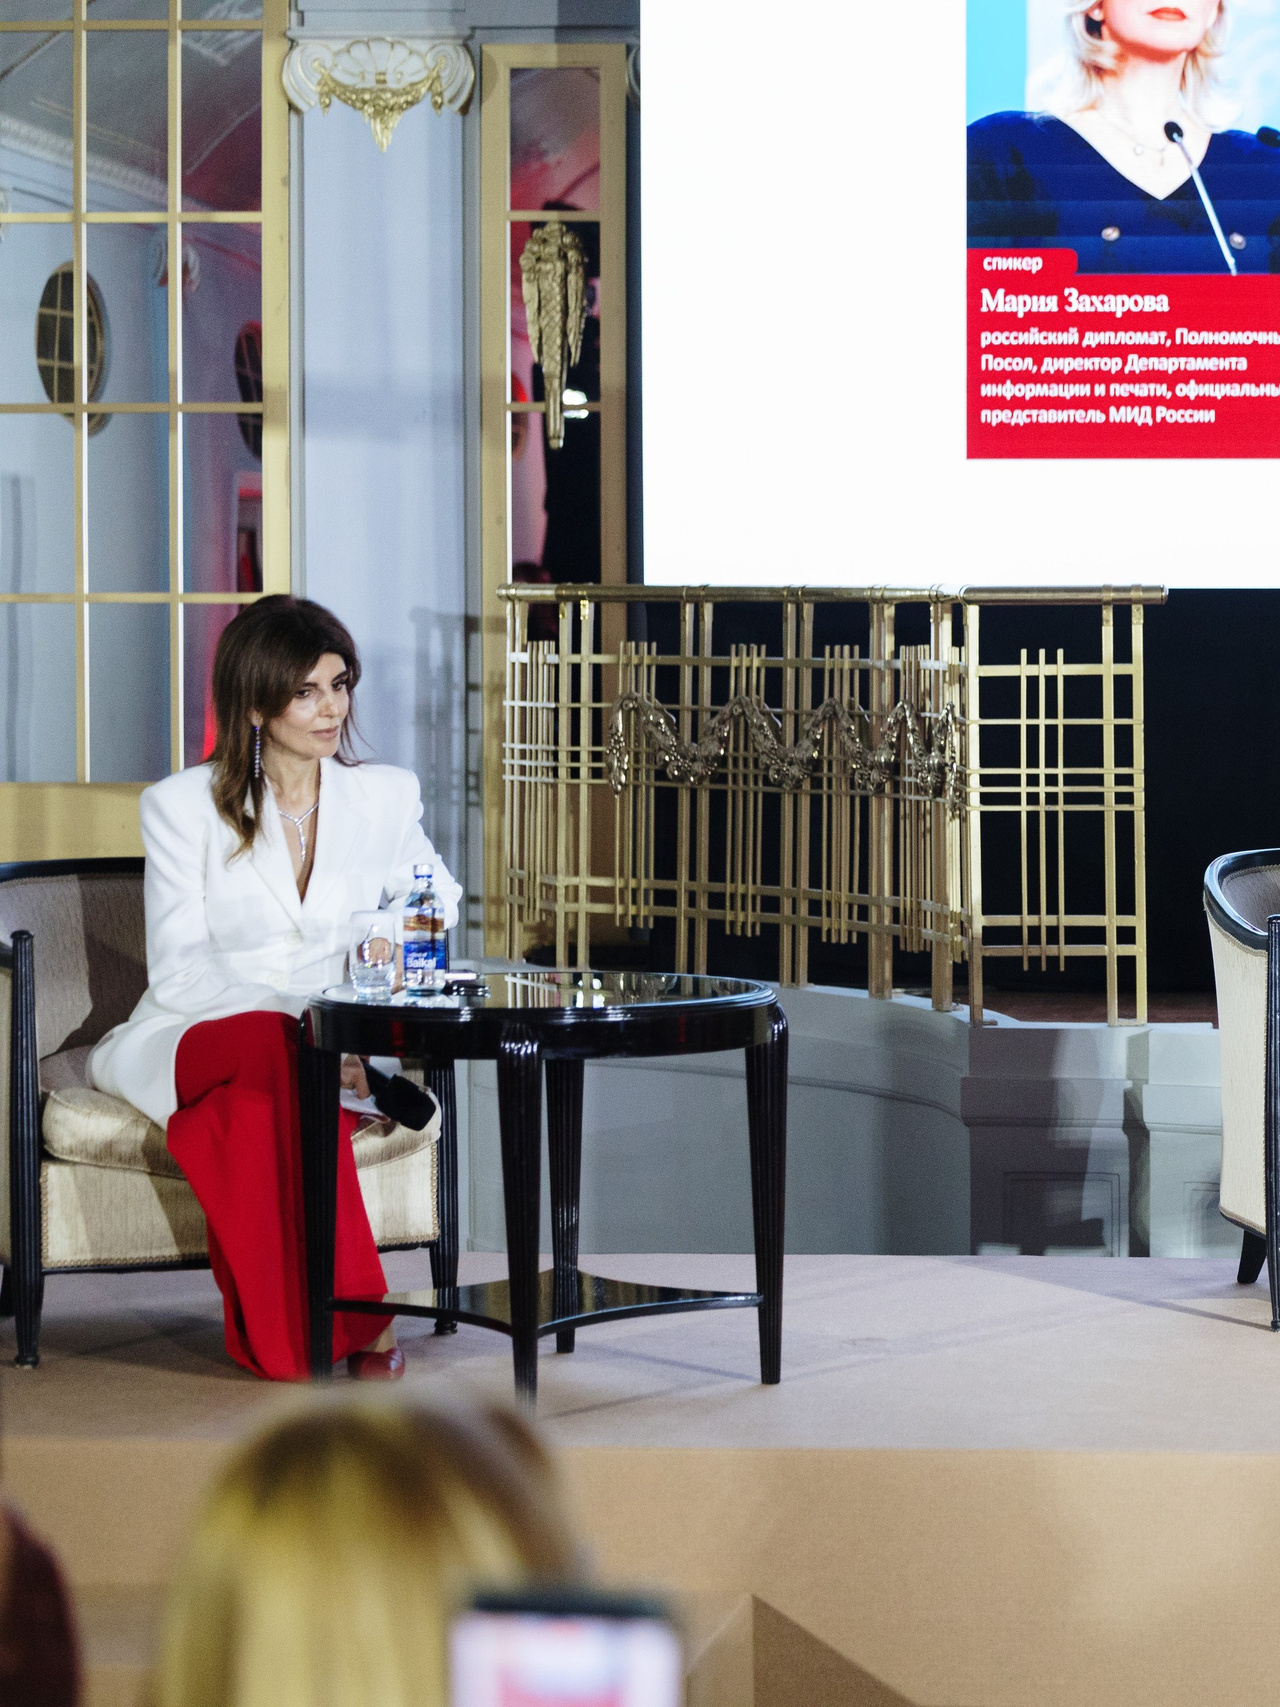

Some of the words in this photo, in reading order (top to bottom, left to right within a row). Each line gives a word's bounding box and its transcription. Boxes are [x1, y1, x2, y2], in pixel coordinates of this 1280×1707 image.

[983, 255, 1043, 274] спикер
[981, 288, 1058, 316] Мария
[1064, 287, 1170, 316] Захарова
[981, 327, 1079, 348] российский
[1082, 331, 1171, 348] дипломат,
[981, 354, 1037, 373] Посол,
[1041, 357, 1122, 374] директор
[1124, 354, 1247, 374] Департамента
[981, 380, 1090, 400] информации
[1094, 384, 1106, 396] и
[1110, 383, 1172, 399] печати,
[981, 409, 1106, 426] представитель
[1109, 406, 1153, 426] МИД
[1156, 406, 1215, 423] России
[406, 957, 437, 968] Baikal
